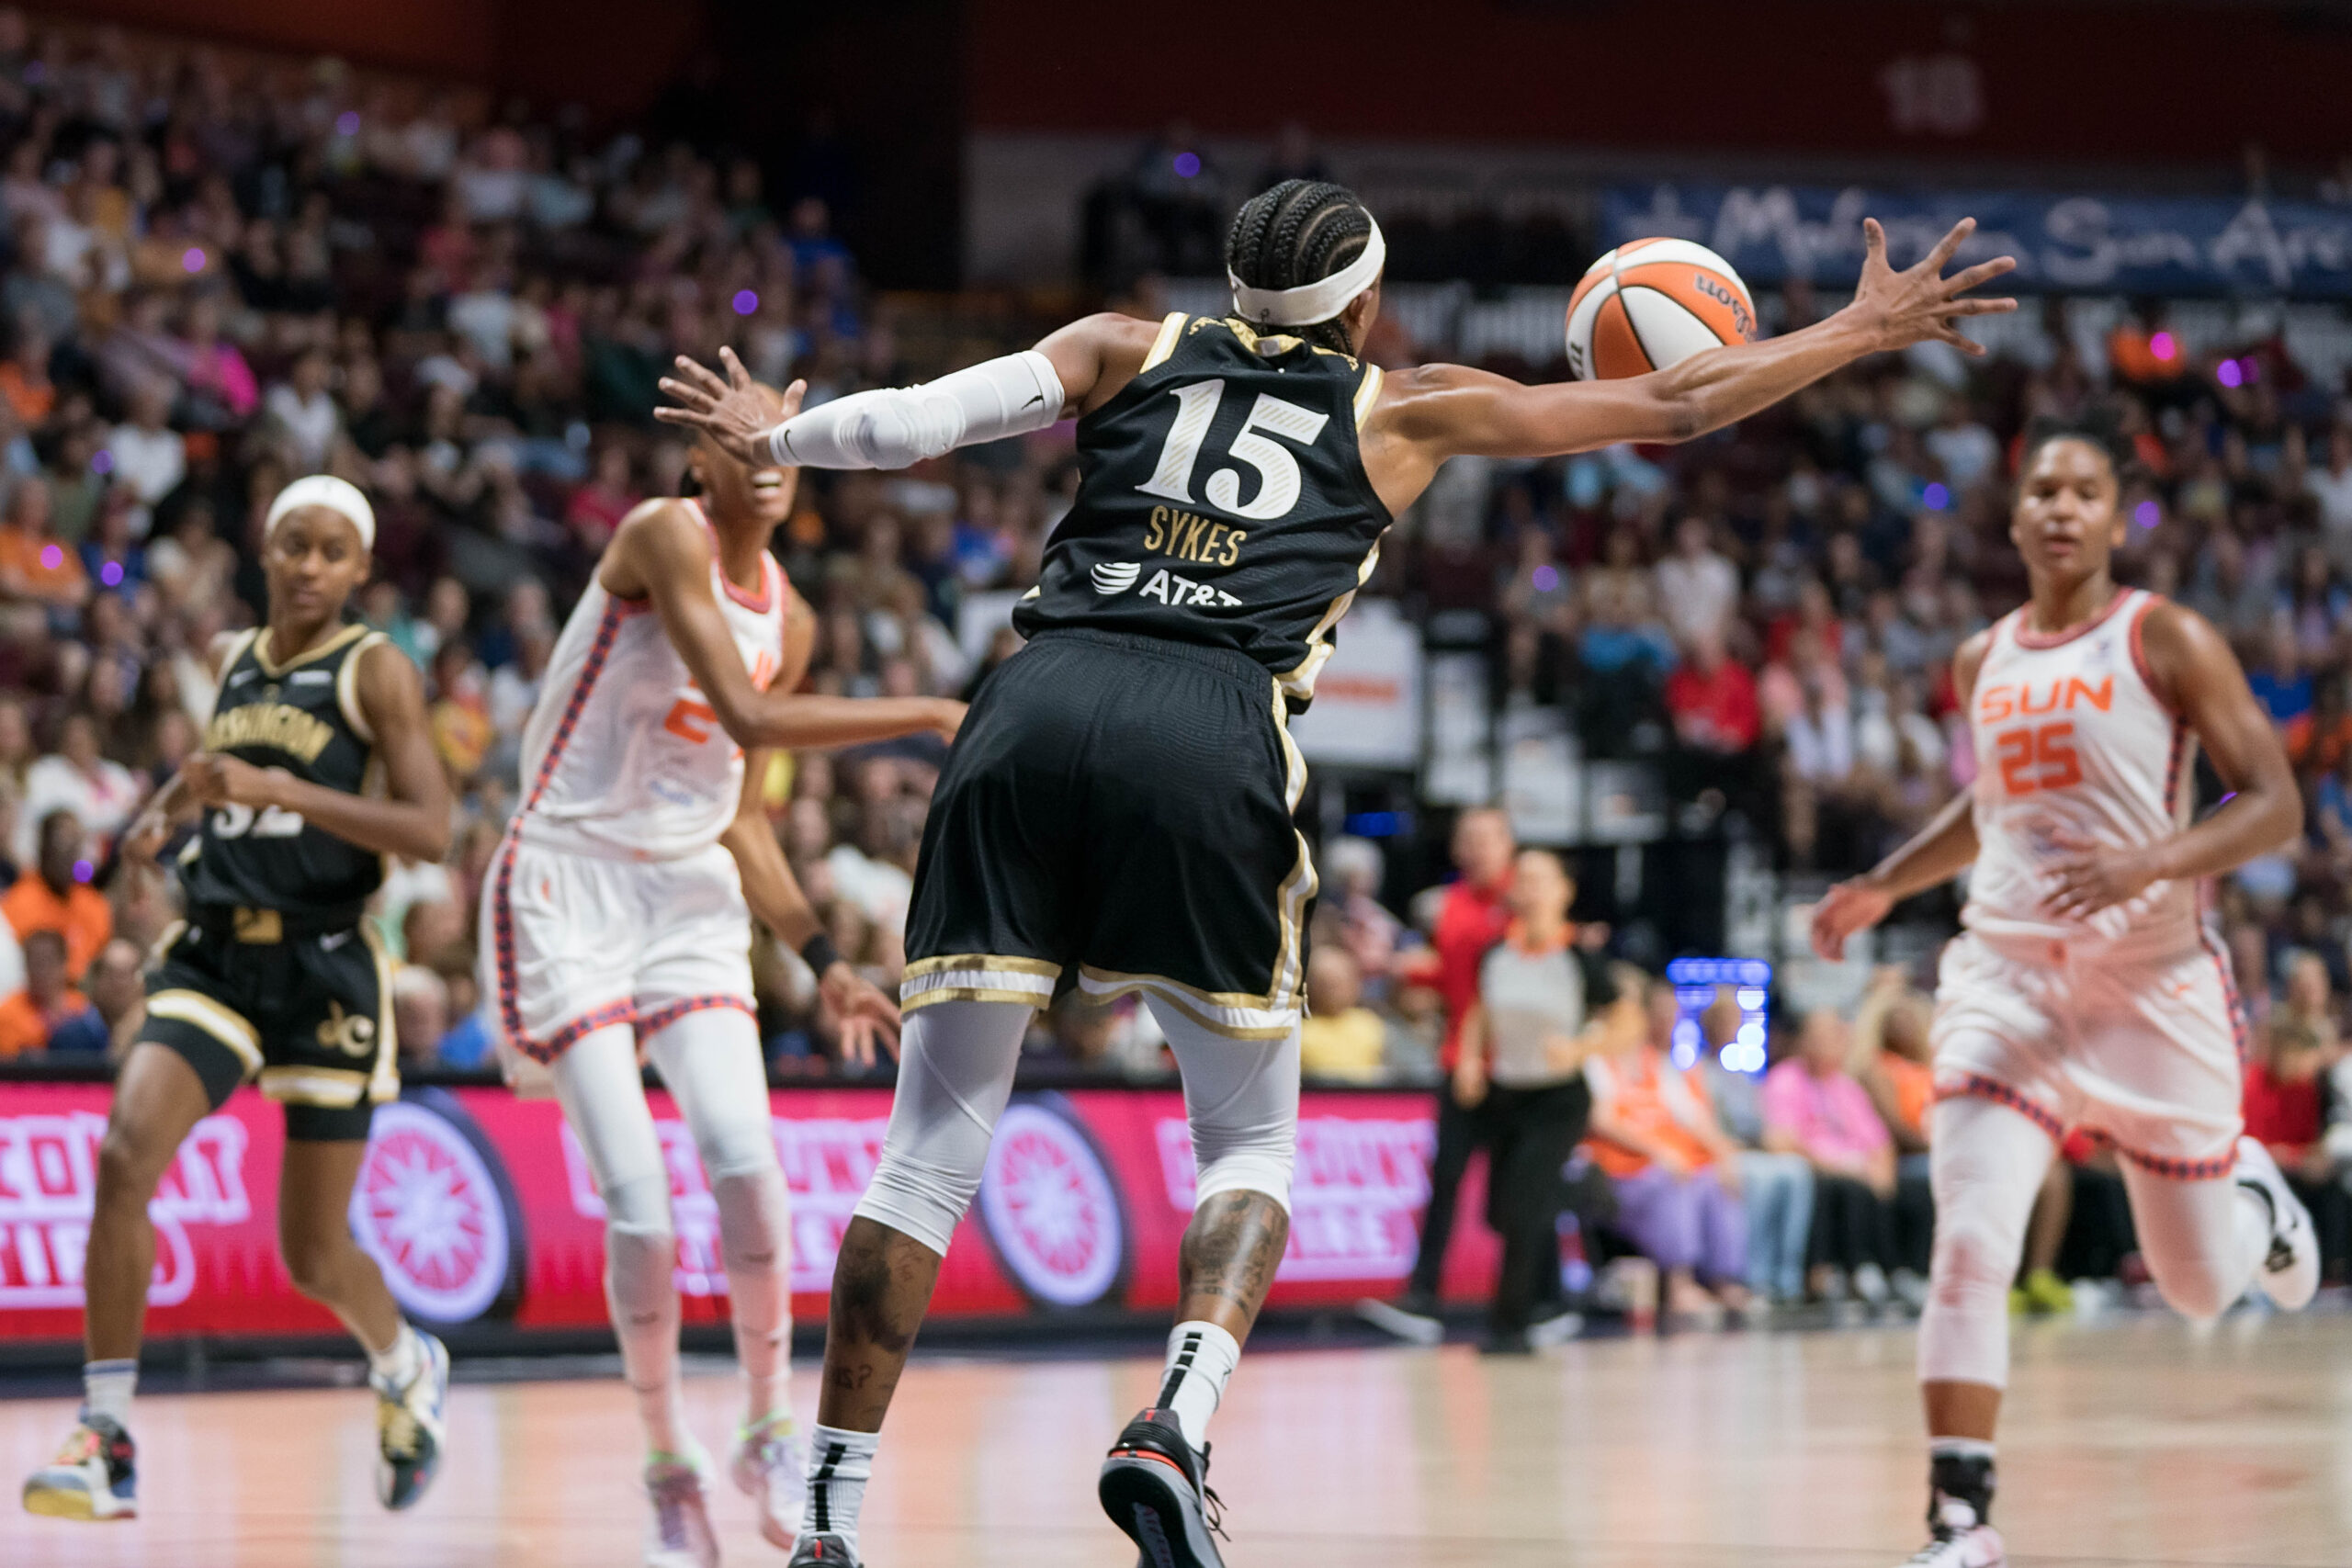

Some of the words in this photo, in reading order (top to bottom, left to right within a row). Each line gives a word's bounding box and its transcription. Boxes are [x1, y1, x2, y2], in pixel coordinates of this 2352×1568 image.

[1135, 378, 1329, 520] 15
[1144, 505, 1247, 566] SYKES
[1139, 569, 1243, 606] AT&T
[1981, 675, 2114, 726] SUN
[1997, 722, 2084, 795] 25
